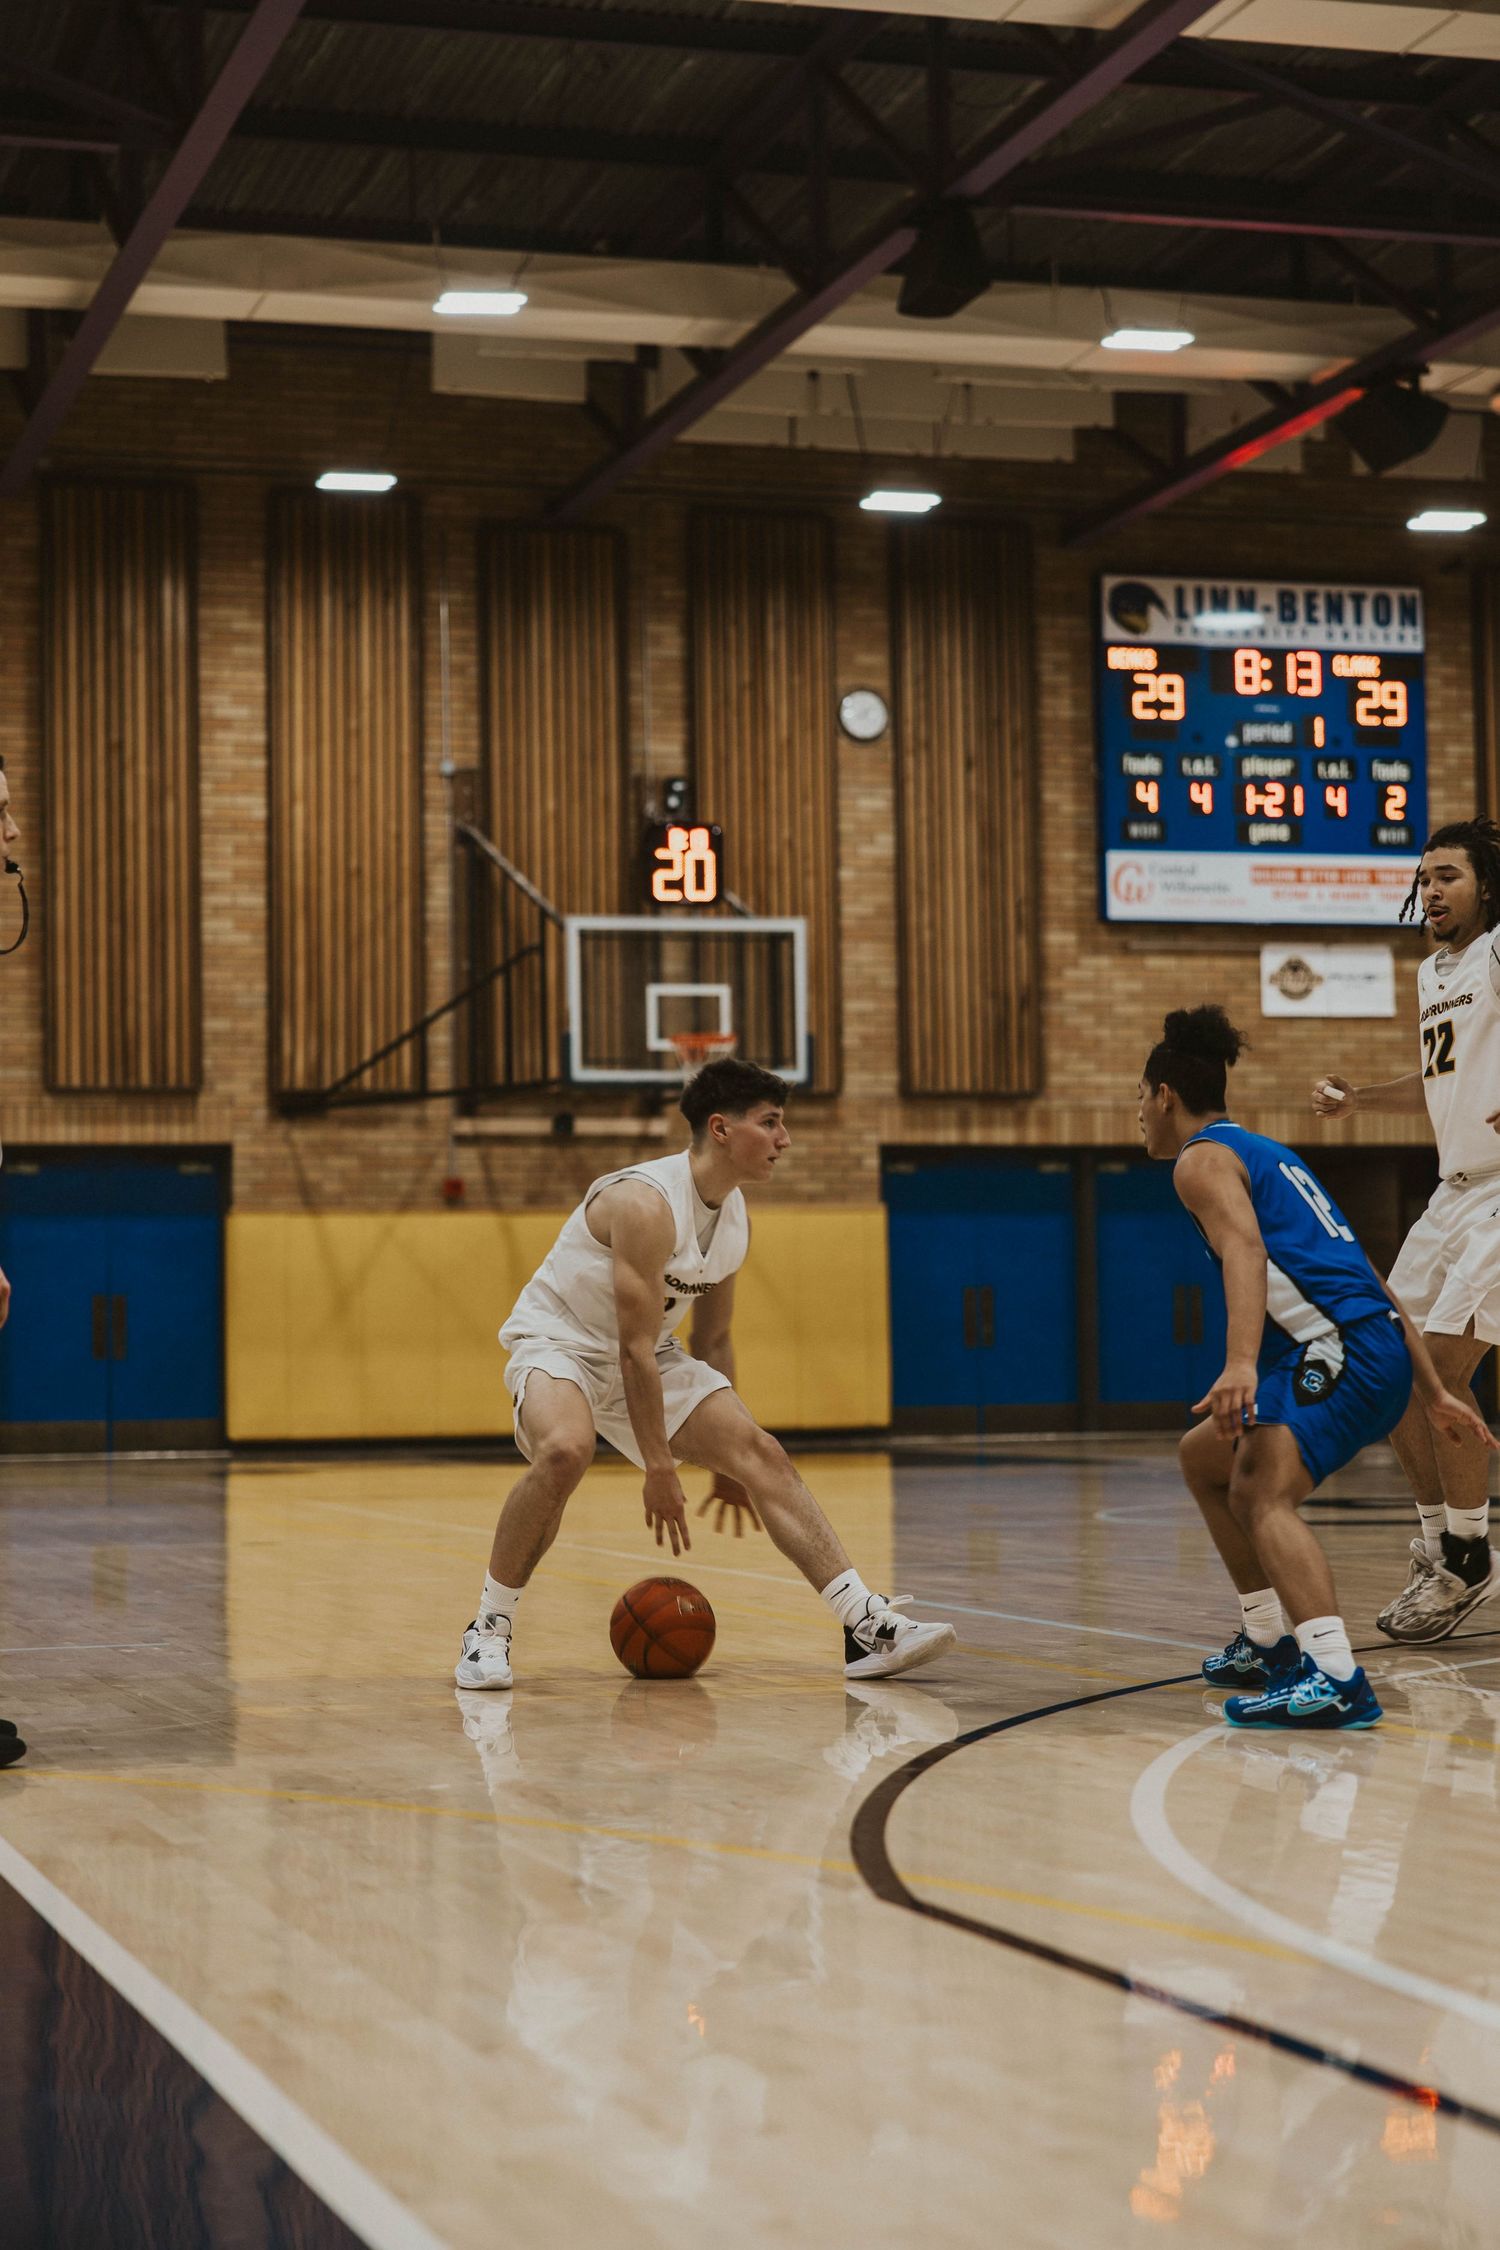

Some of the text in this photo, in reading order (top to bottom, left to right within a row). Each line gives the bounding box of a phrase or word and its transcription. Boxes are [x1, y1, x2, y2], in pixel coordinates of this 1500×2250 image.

[1174, 584, 1418, 628] LINN-BENTON
[1234, 648, 1322, 697] 8:13
[1132, 673, 1185, 721] 29
[1356, 680, 1408, 727] 29
[1313, 716, 1325, 748] 1
[1136, 781, 1159, 813] 4
[1190, 782, 1213, 814] 4
[1325, 785, 1348, 818] 4
[1384, 784, 1407, 821] 2
[652, 847, 717, 902] 20
[1423, 1018, 1456, 1080] 22
